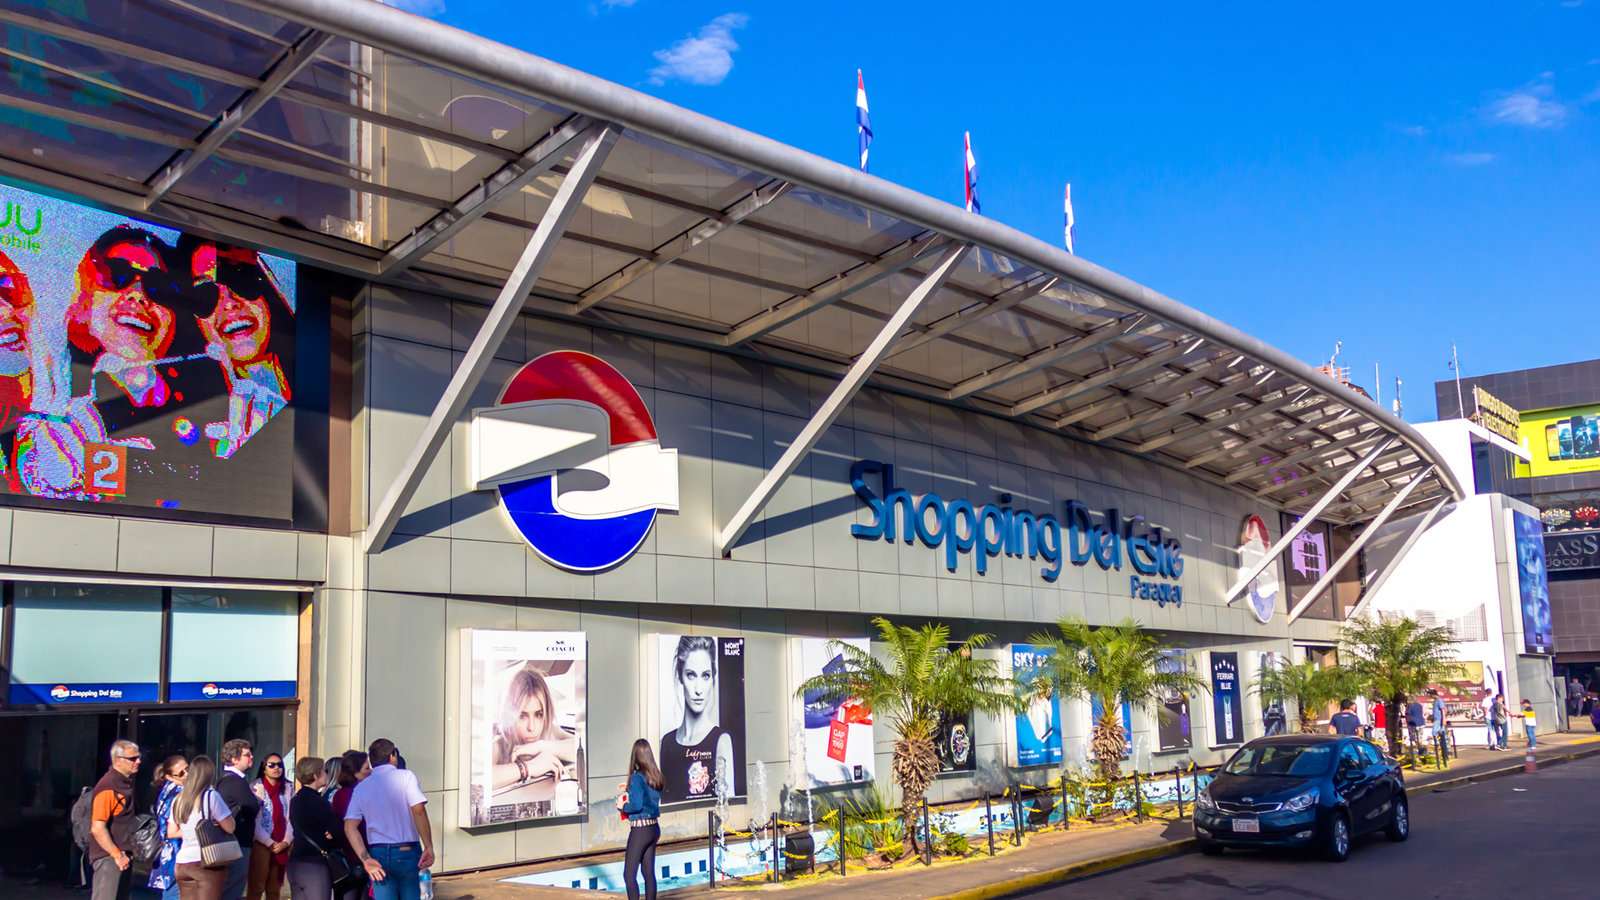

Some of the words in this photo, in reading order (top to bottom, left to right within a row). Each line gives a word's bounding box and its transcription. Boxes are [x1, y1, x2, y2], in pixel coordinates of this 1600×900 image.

[93, 450, 118, 489] 2
[850, 459, 1063, 582] Shopping
[1066, 499, 1122, 571] Del
[1126, 515, 1184, 580] Este
[1130, 575, 1183, 609] Paraguay
[1014, 652, 1034, 667] SKY
[70, 689, 98, 698] Shopping
[219, 687, 242, 695] Shopping
[833, 729, 845, 738] GAP
